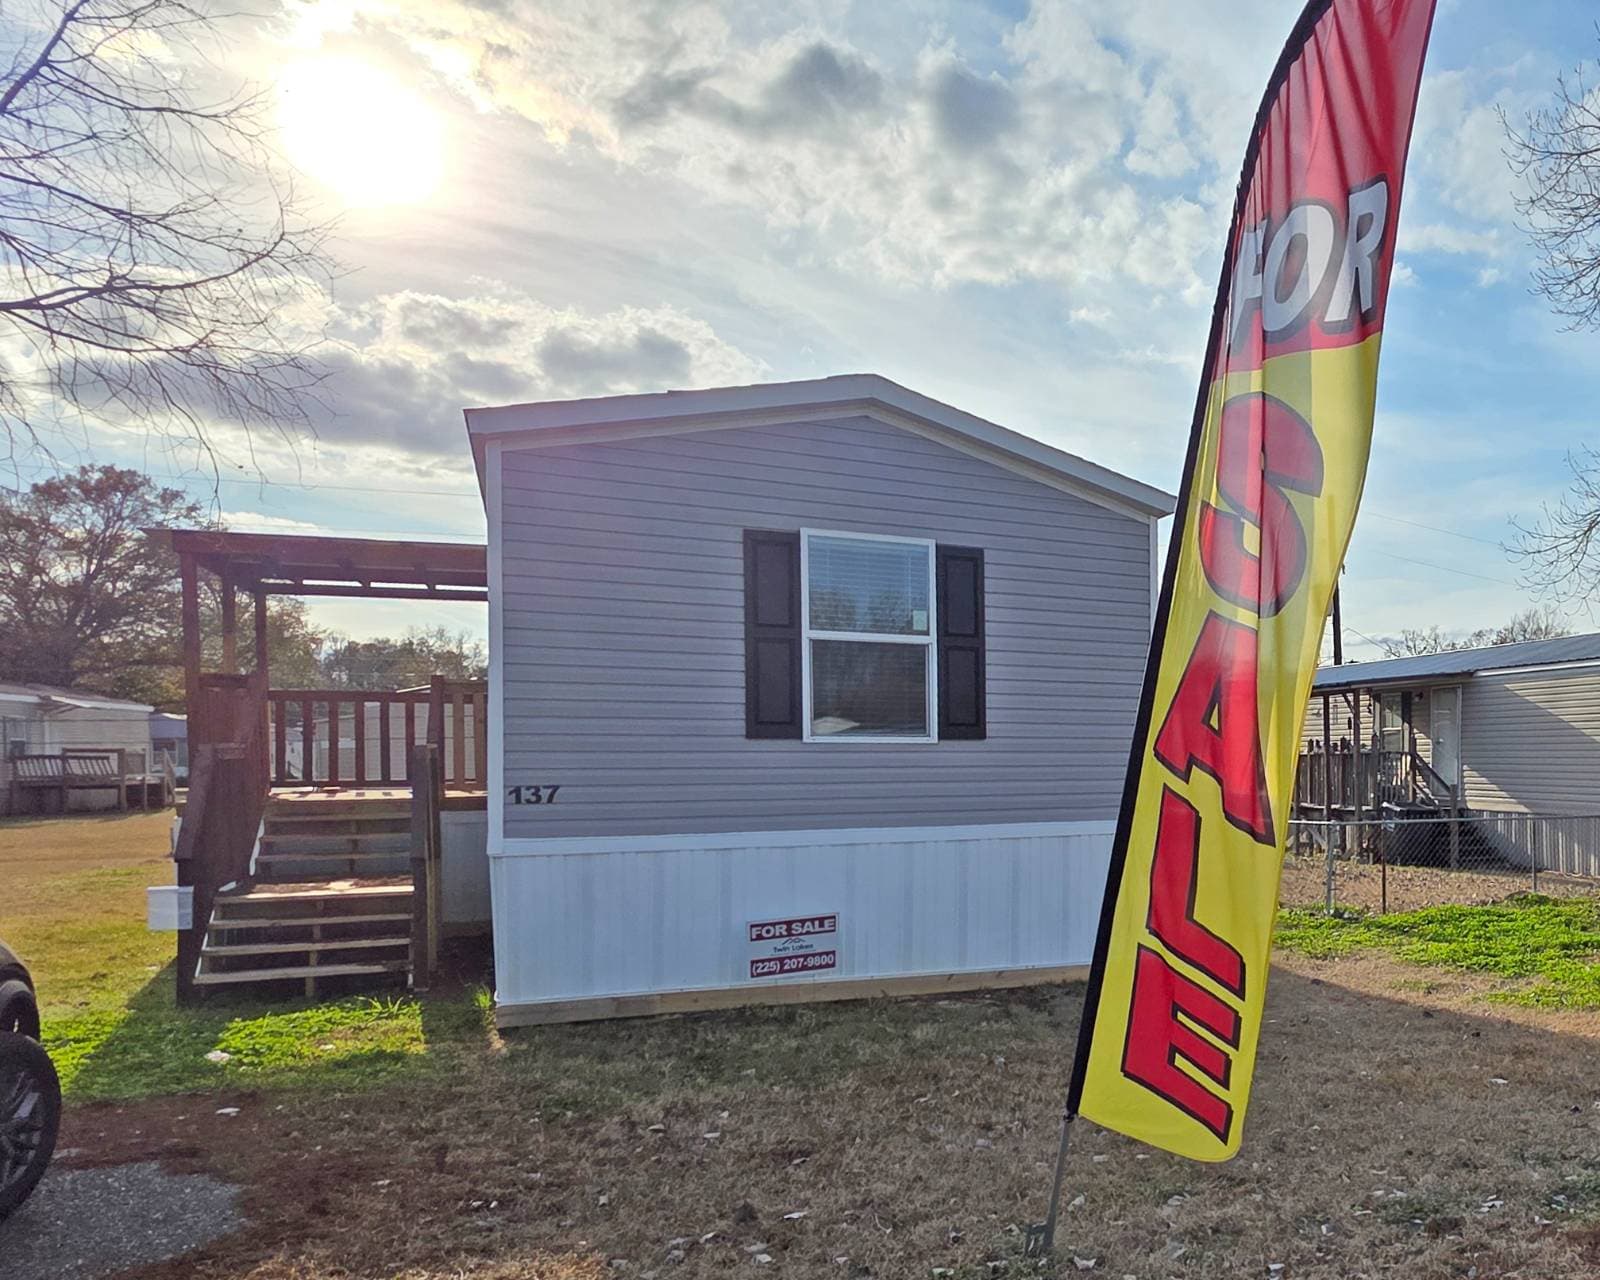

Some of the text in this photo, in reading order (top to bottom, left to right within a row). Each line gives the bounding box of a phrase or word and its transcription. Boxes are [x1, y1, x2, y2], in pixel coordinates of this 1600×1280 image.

[1230, 175, 1388, 350] FOR
[1121, 392, 1324, 1146] SALE
[508, 785, 560, 804] 137
[751, 918, 835, 939] FOR SALE
[752, 954, 834, 976] (225) 207-9800
